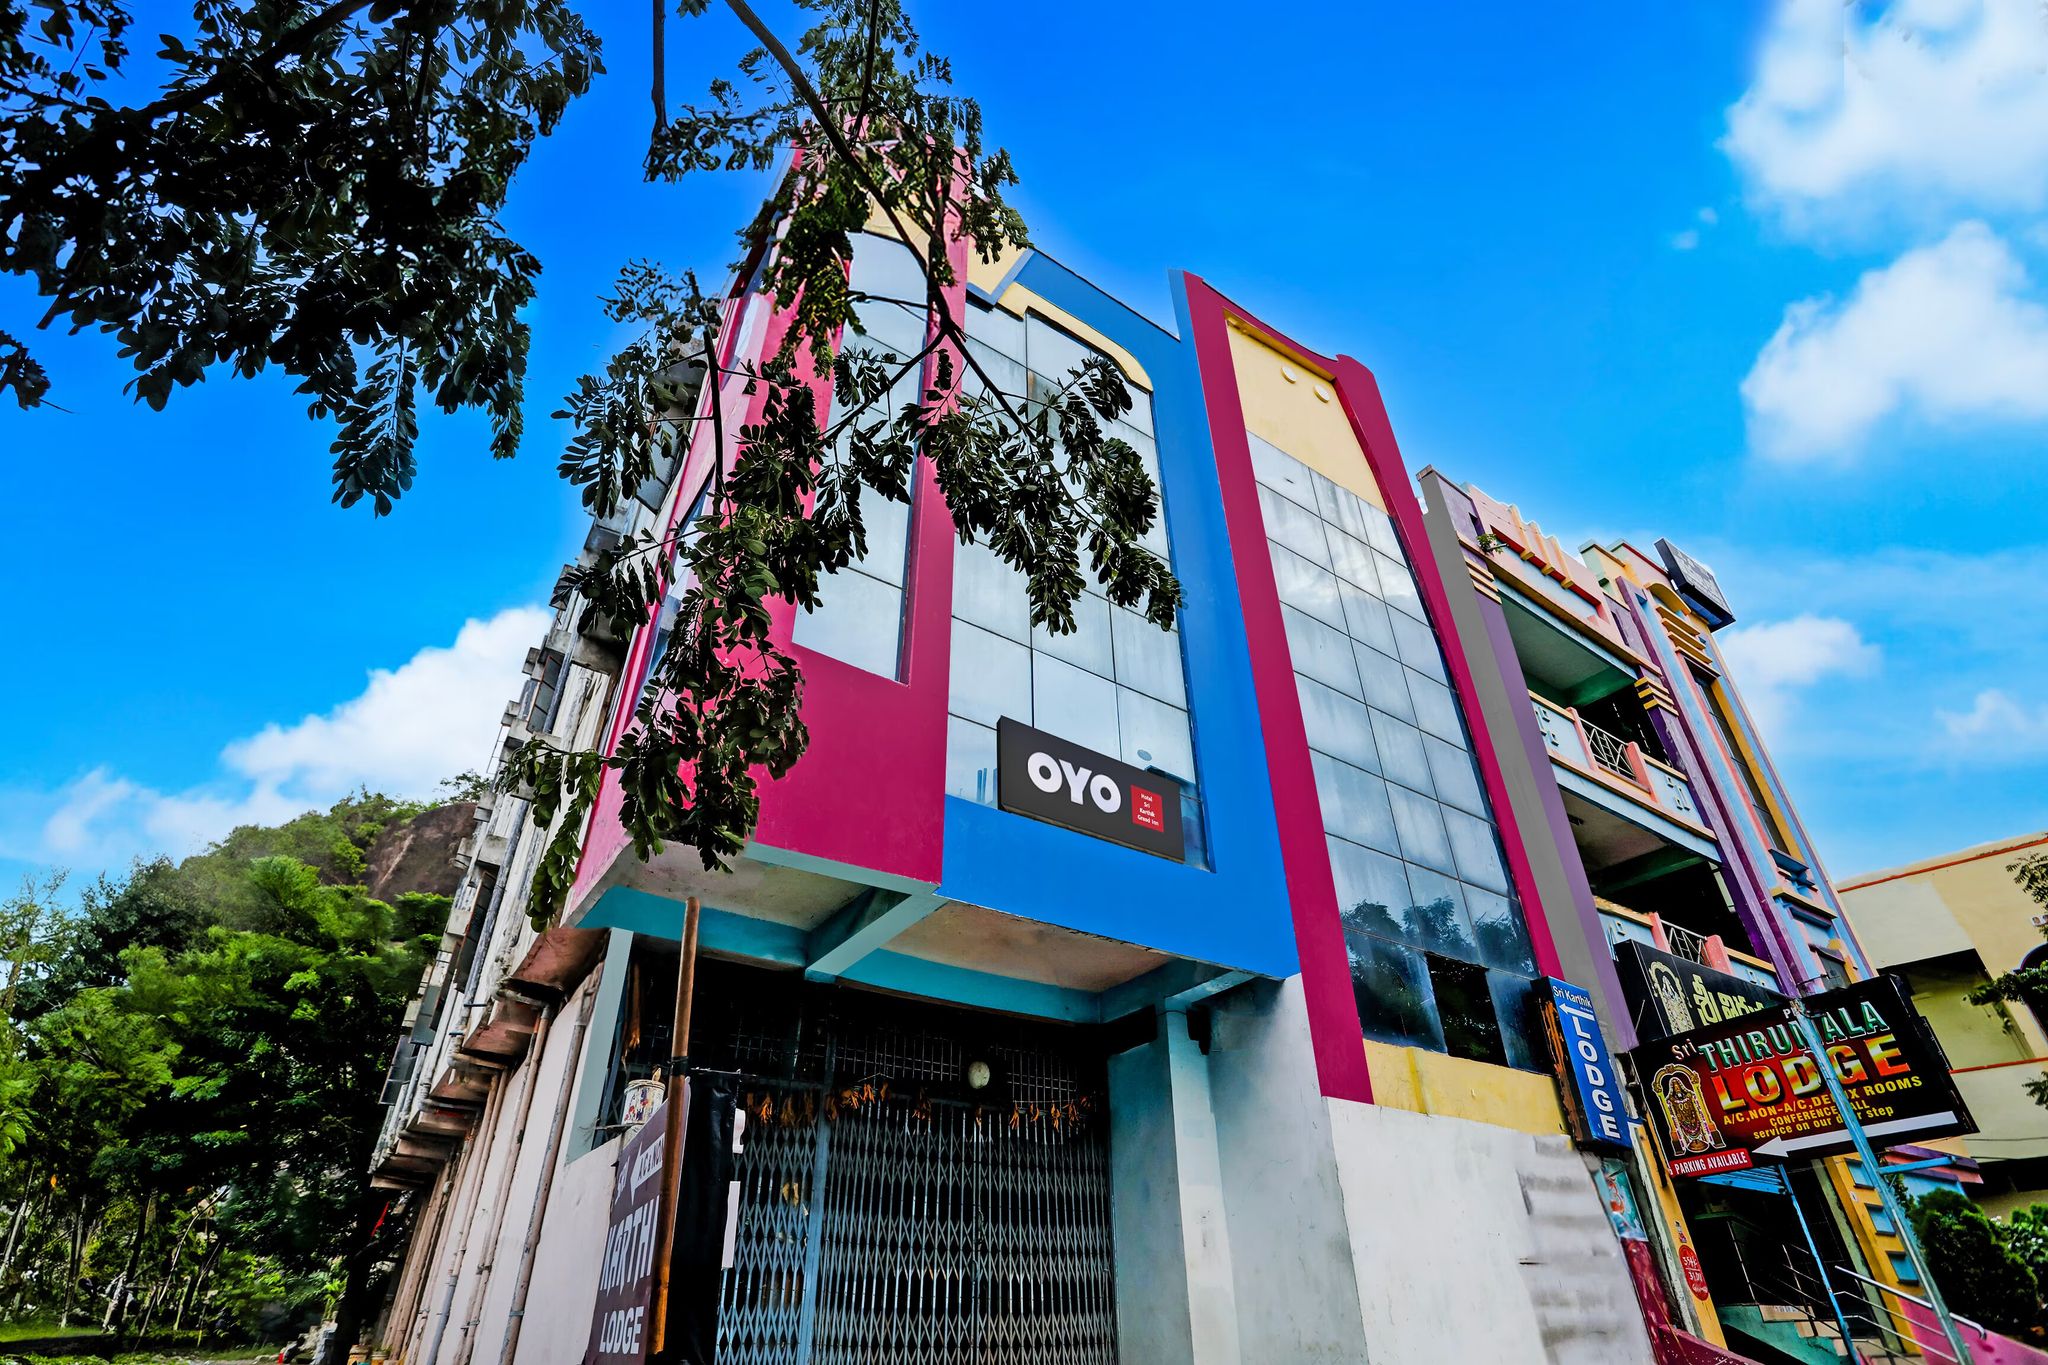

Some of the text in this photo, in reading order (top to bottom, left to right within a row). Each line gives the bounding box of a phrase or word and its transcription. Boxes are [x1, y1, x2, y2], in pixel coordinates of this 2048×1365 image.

[1027, 751, 1122, 814] OYO
[1552, 985, 1592, 1008] Sri Karthik
[1671, 1038, 1698, 1061] Sri
[1571, 1015, 1621, 1139] LODGE
[1711, 1033, 1911, 1111] LODGE
[1863, 1076, 1923, 1097] ROOMS
[1753, 1105, 1895, 1140] service on our dr step
[1769, 1105, 1839, 1127] CONFERENCE
[1674, 1158, 1707, 1175] PARKING
[1706, 1151, 1748, 1169] AVAILABLE
[600, 1195, 660, 1297] KARTHI
[599, 1305, 645, 1355] LODGE
